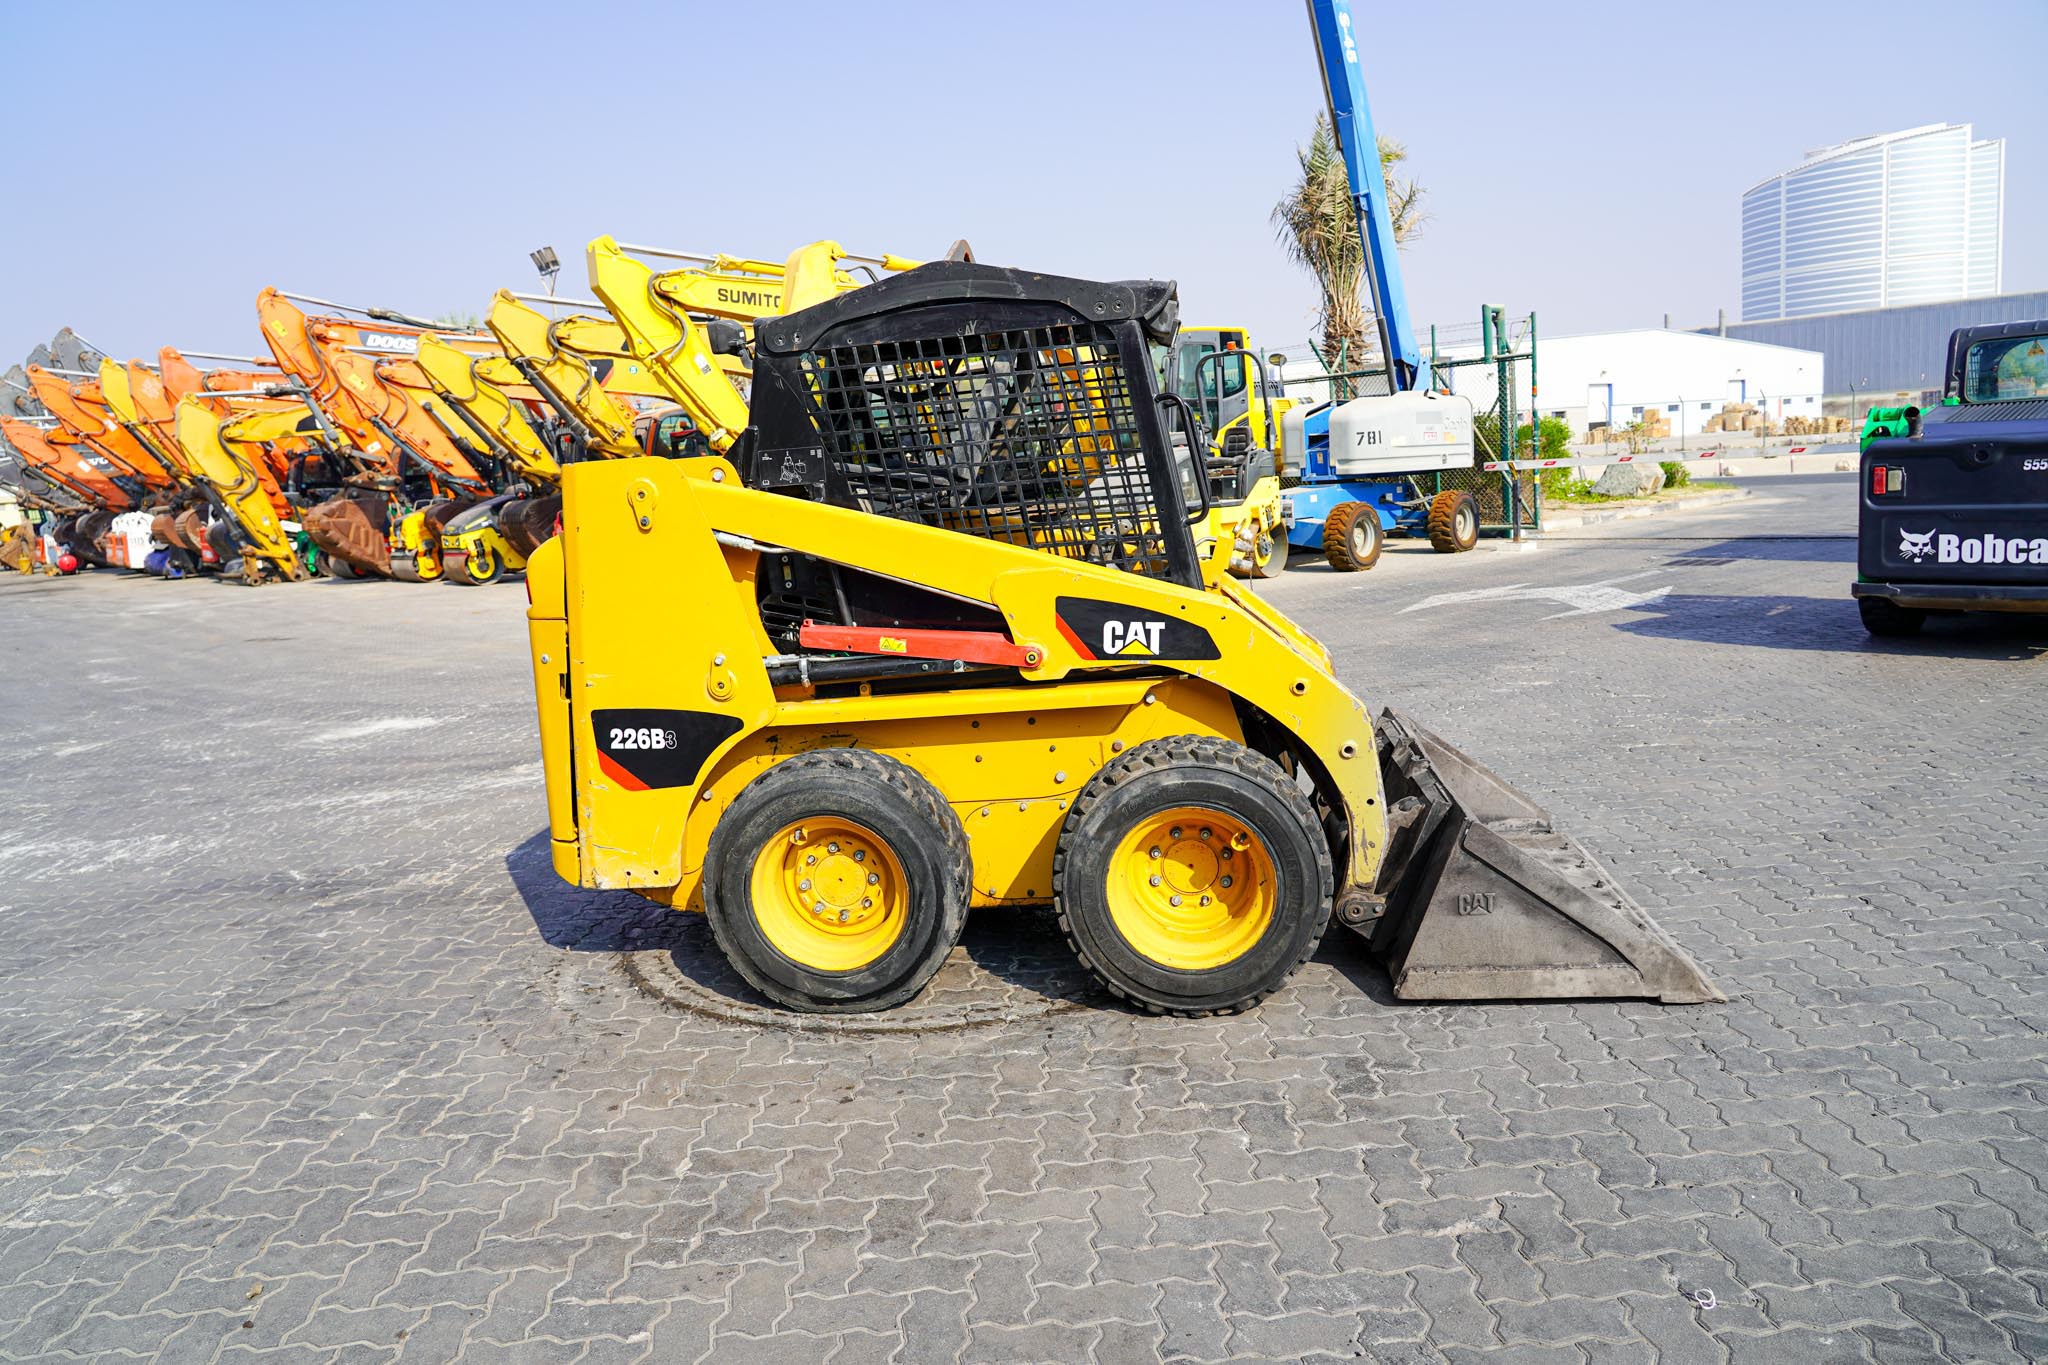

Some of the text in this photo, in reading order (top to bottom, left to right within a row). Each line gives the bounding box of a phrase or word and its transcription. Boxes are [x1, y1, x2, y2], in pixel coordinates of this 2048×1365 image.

[1356, 430, 1382, 446] 781
[1938, 533, 2048, 563] Bobca
[1103, 620, 1166, 655] CAT
[1457, 892, 1496, 915] CAT
